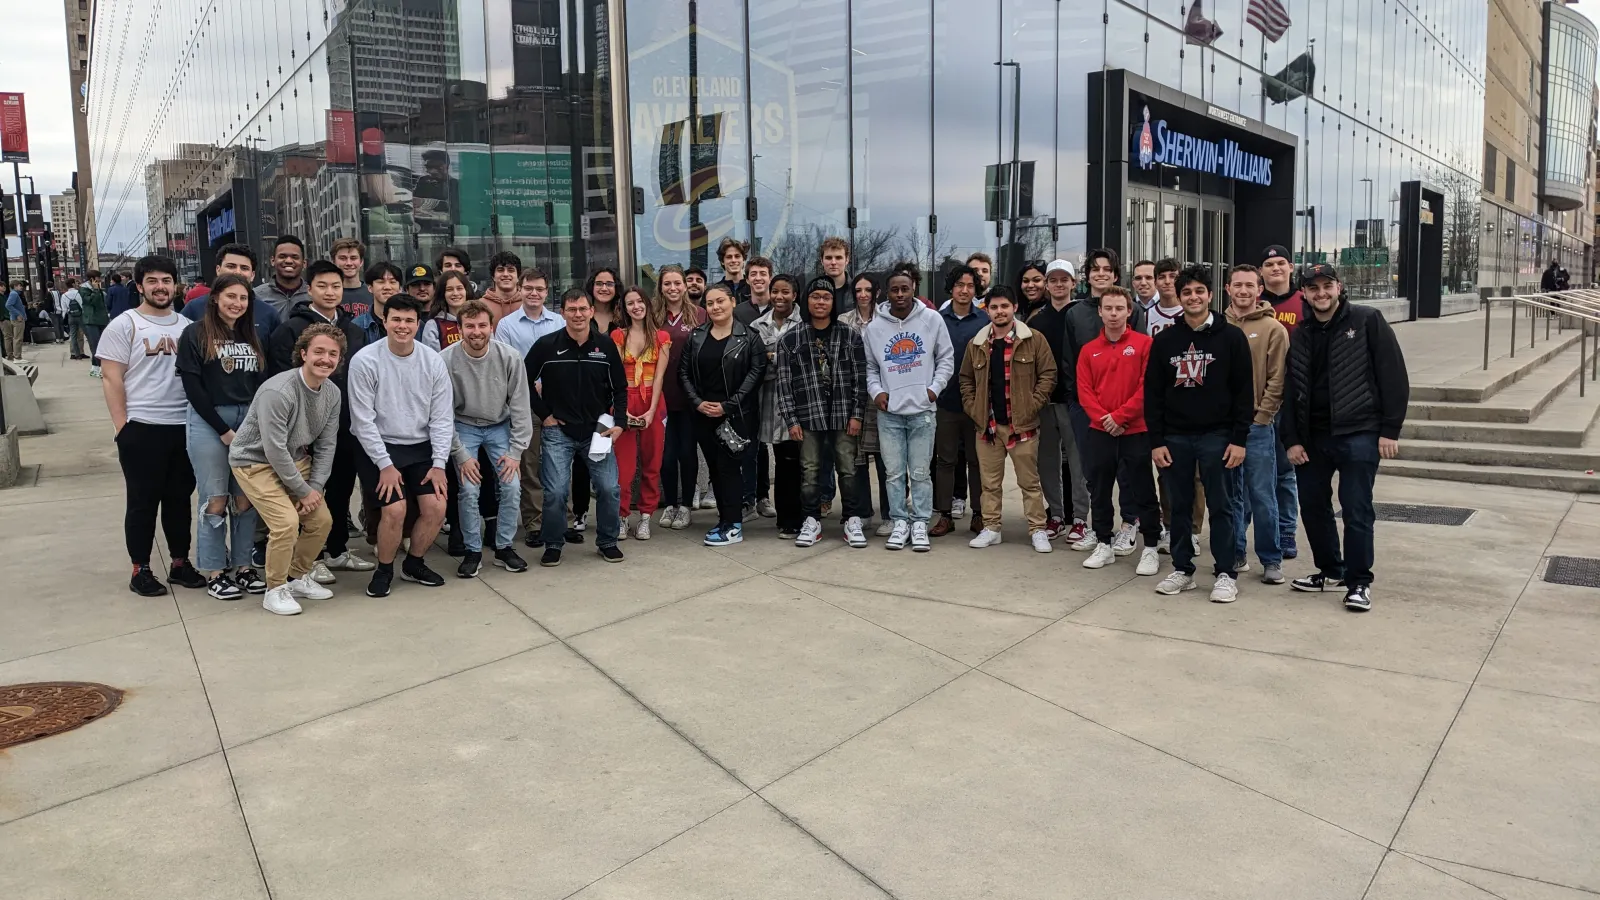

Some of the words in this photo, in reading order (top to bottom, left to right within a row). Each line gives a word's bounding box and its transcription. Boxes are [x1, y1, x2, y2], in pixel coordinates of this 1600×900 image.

[652, 76, 741, 97] CLEVELAND
[633, 102, 785, 145] AVALIERS
[143, 336, 178, 356] LAN
[884, 331, 924, 354] CLEVELAND
